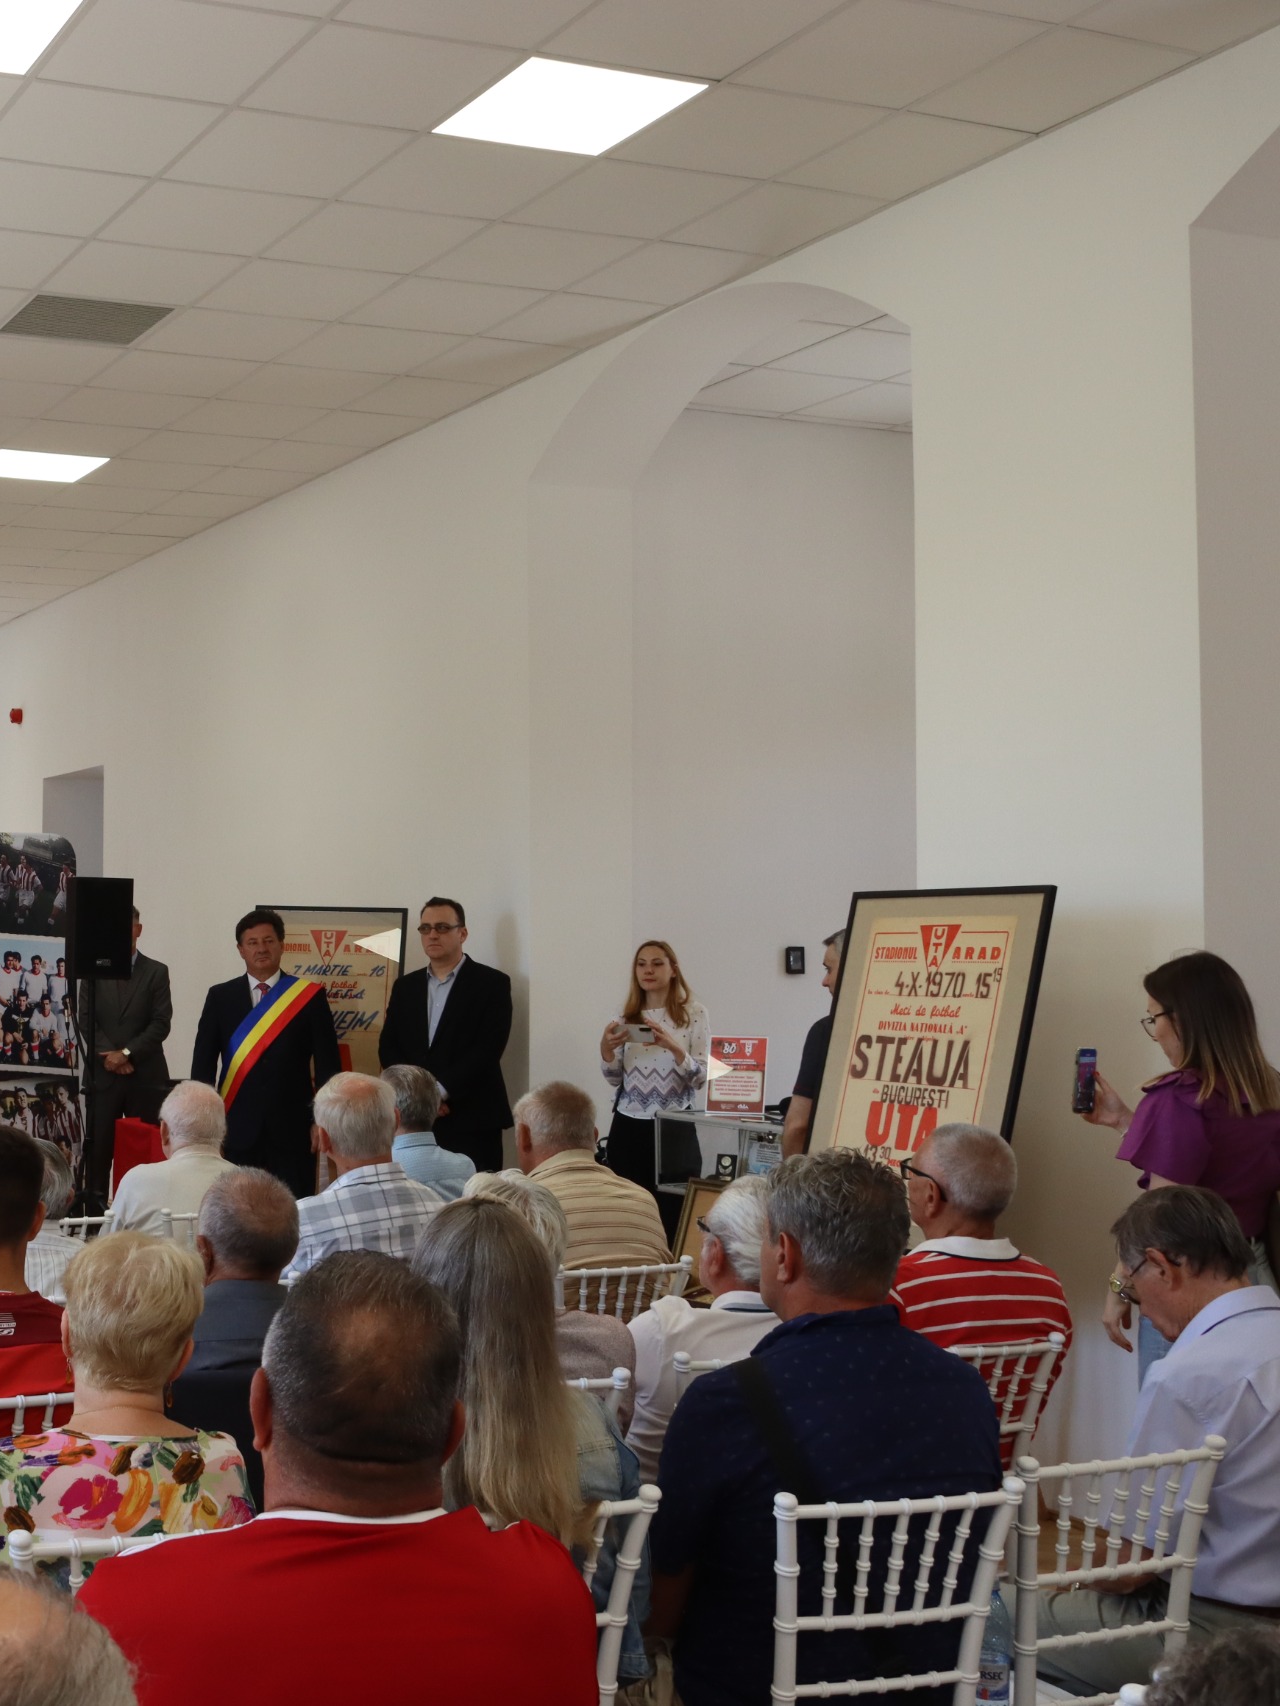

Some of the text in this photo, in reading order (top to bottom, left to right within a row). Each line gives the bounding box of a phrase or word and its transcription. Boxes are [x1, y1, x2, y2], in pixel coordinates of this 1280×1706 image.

[323, 932, 334, 957] UTA
[928, 927, 946, 968] UTA
[874, 946, 1002, 960] STADIONUL ARAD
[293, 965, 303, 975] 7
[303, 964, 353, 977] MARTIE
[890, 1003, 962, 1019] Meci de fotbal
[878, 1020, 907, 1031] DIVIZIA
[850, 1034, 971, 1089] STEAUA
[865, 1100, 938, 1153] UTA
[980, 1670, 1003, 1681] RSEC
